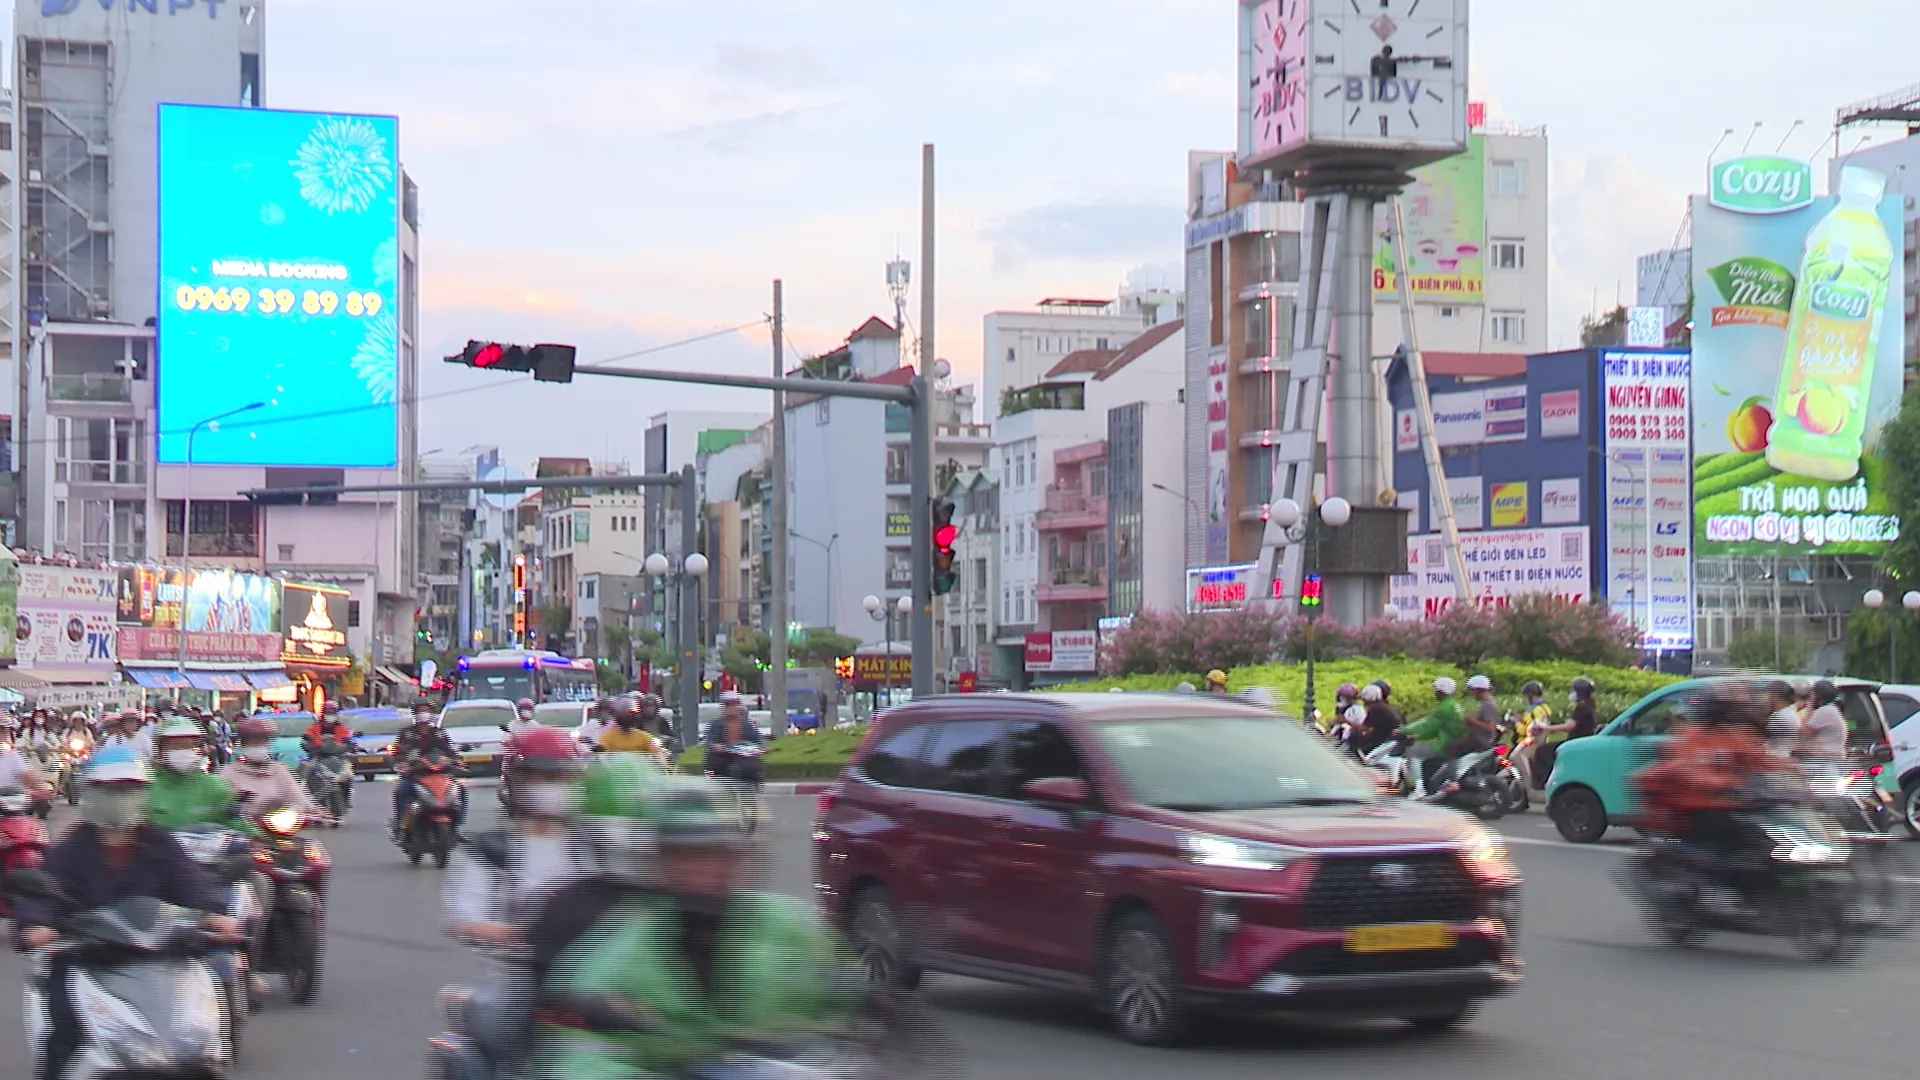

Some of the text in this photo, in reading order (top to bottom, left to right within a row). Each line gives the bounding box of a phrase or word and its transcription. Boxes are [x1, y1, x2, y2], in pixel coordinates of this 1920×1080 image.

[1262, 80, 1298, 117] BIDV
[1347, 77, 1422, 105] BIDV
[1721, 164, 1803, 203] Cozy
[268, 261, 348, 280] BOOKING
[176, 285, 383, 317] 0969 39 89 89
[1813, 286, 1867, 316] Cozy
[1433, 408, 1482, 424] Panasonic
[1494, 496, 1523, 508] MPE
[1782, 486, 1820, 512] HOA
[889, 514, 911, 524] YOG
[1656, 521, 1681, 535] LS
[1527, 547, 1546, 559] LED
[1483, 566, 1511, 582] THIẾT
[99, 579, 115, 598] 7K
[88, 633, 110, 659] 7K
[889, 656, 912, 671] KÍN
